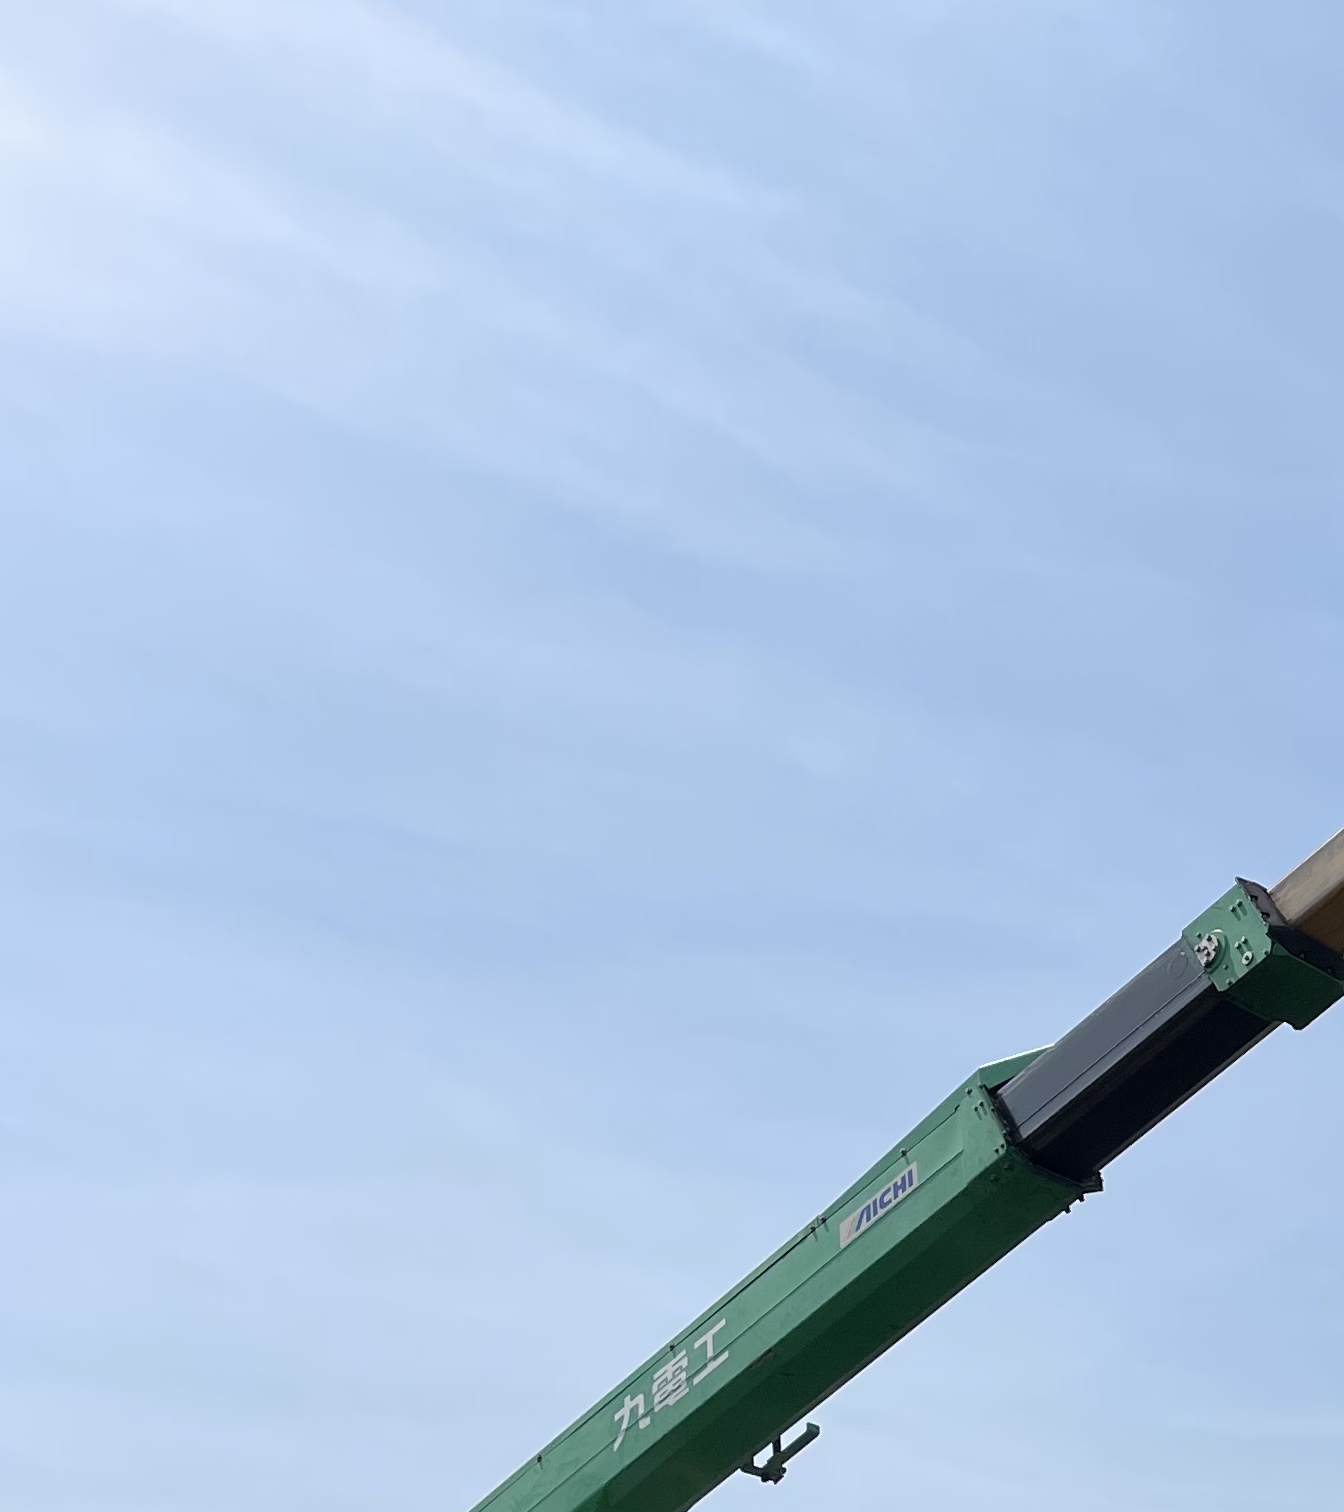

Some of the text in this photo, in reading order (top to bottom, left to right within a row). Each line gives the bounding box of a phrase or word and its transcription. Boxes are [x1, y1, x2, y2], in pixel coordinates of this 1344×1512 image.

[855, 1168, 914, 1233] AICHI
[613, 1317, 729, 1453] 九電工
